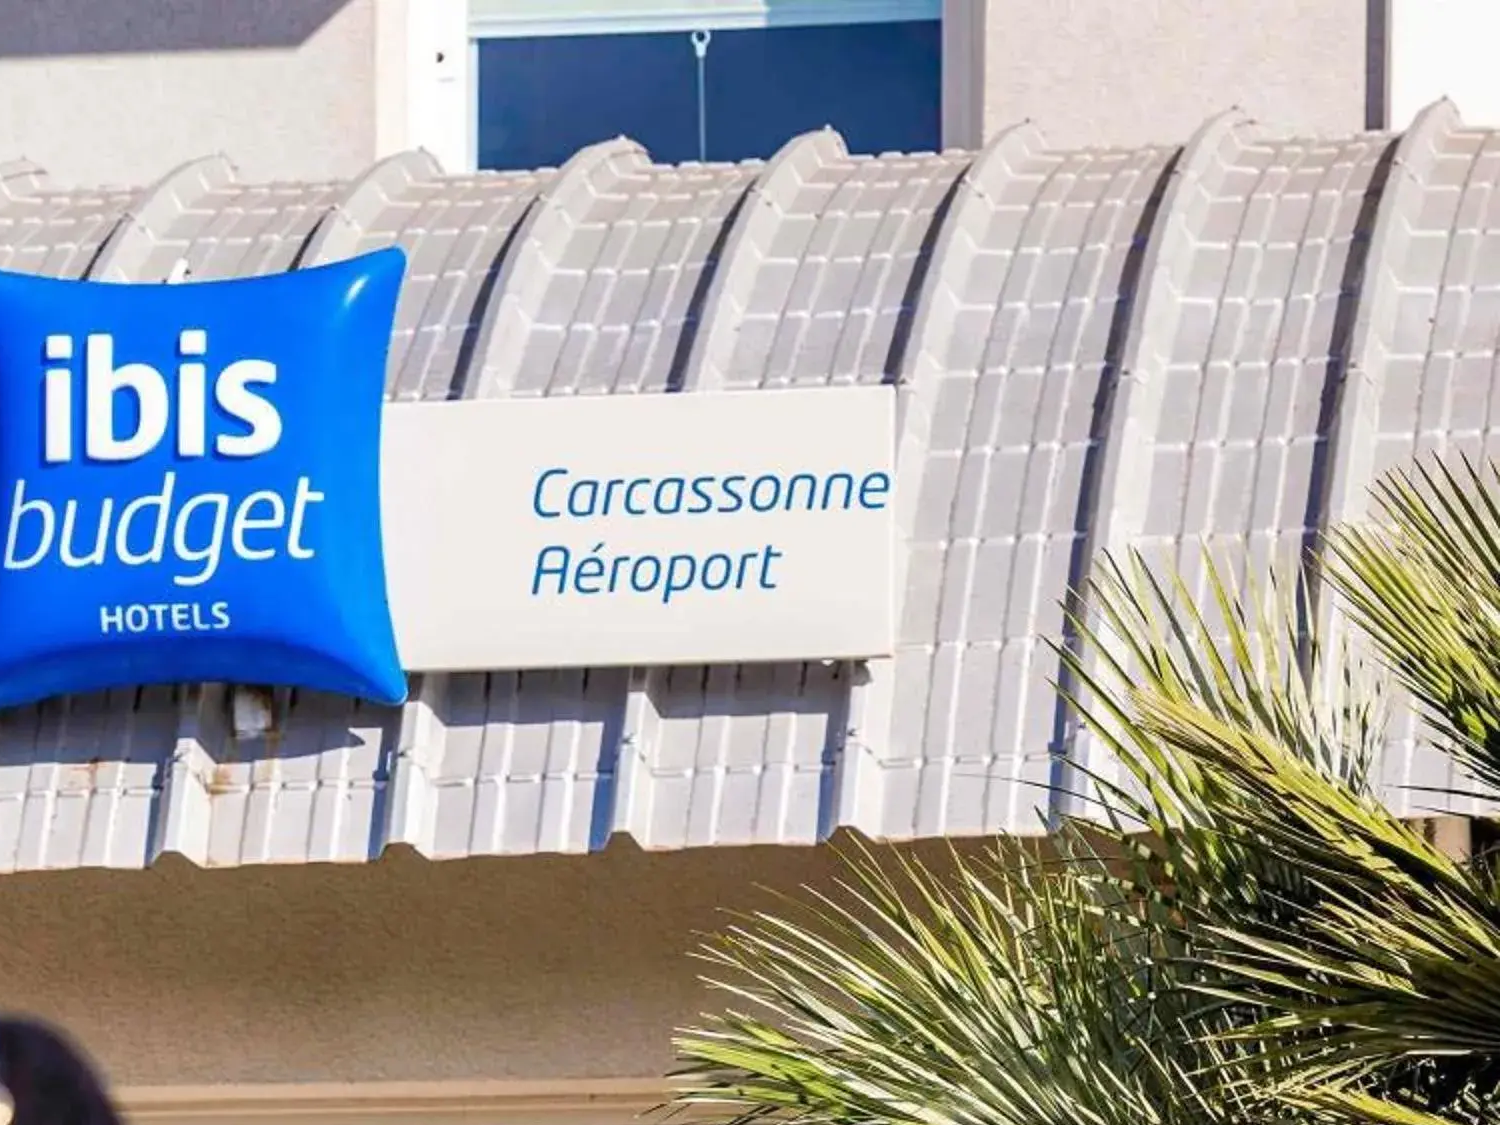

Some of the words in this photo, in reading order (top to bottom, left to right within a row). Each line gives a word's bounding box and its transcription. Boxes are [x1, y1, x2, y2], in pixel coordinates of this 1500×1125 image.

[44, 329, 283, 464] ibis
[532, 468, 891, 518] Carcassonne
[3, 472, 324, 587] budget
[531, 542, 782, 604] Aéroport
[100, 602, 231, 633] HOTELS
